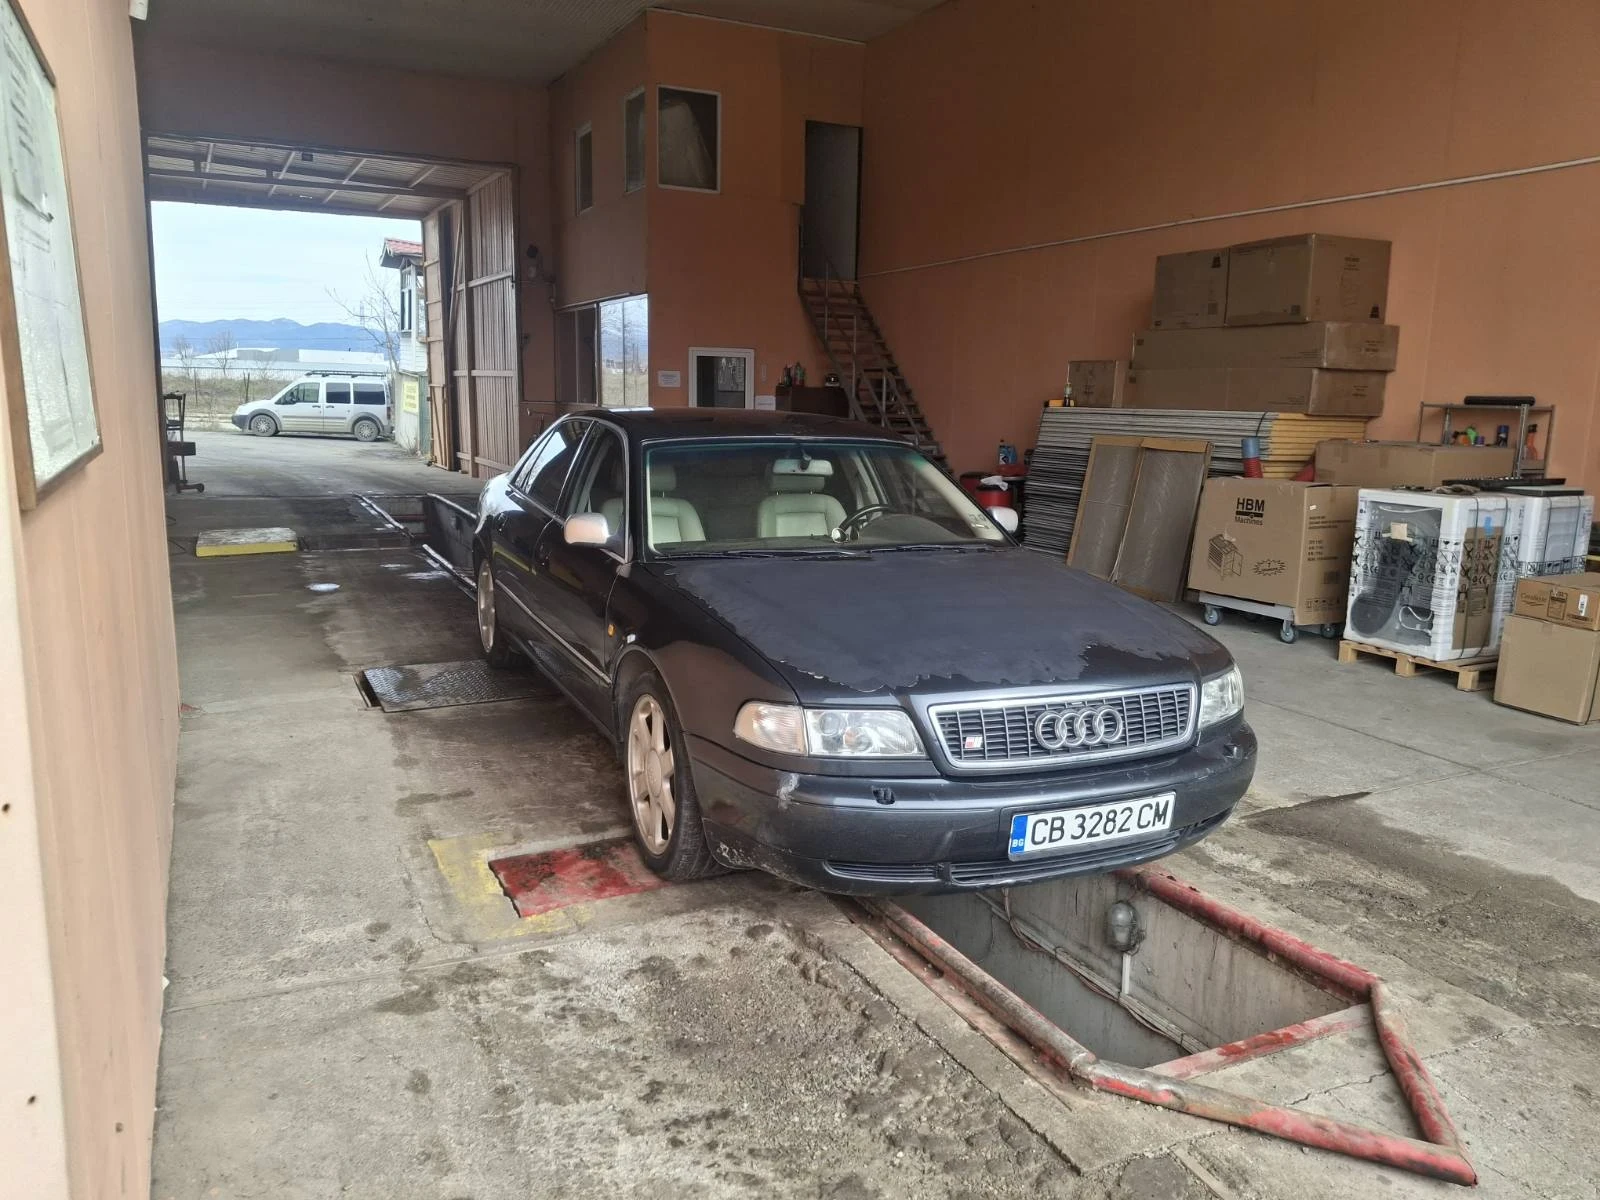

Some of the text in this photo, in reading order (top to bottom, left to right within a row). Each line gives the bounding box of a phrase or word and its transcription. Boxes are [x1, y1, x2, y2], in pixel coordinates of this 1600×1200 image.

[1236, 497, 1265, 512] HBM
[1235, 516, 1264, 526] Machines
[1030, 800, 1170, 846] CB 3282 CM
[1012, 838, 1024, 848] BG
